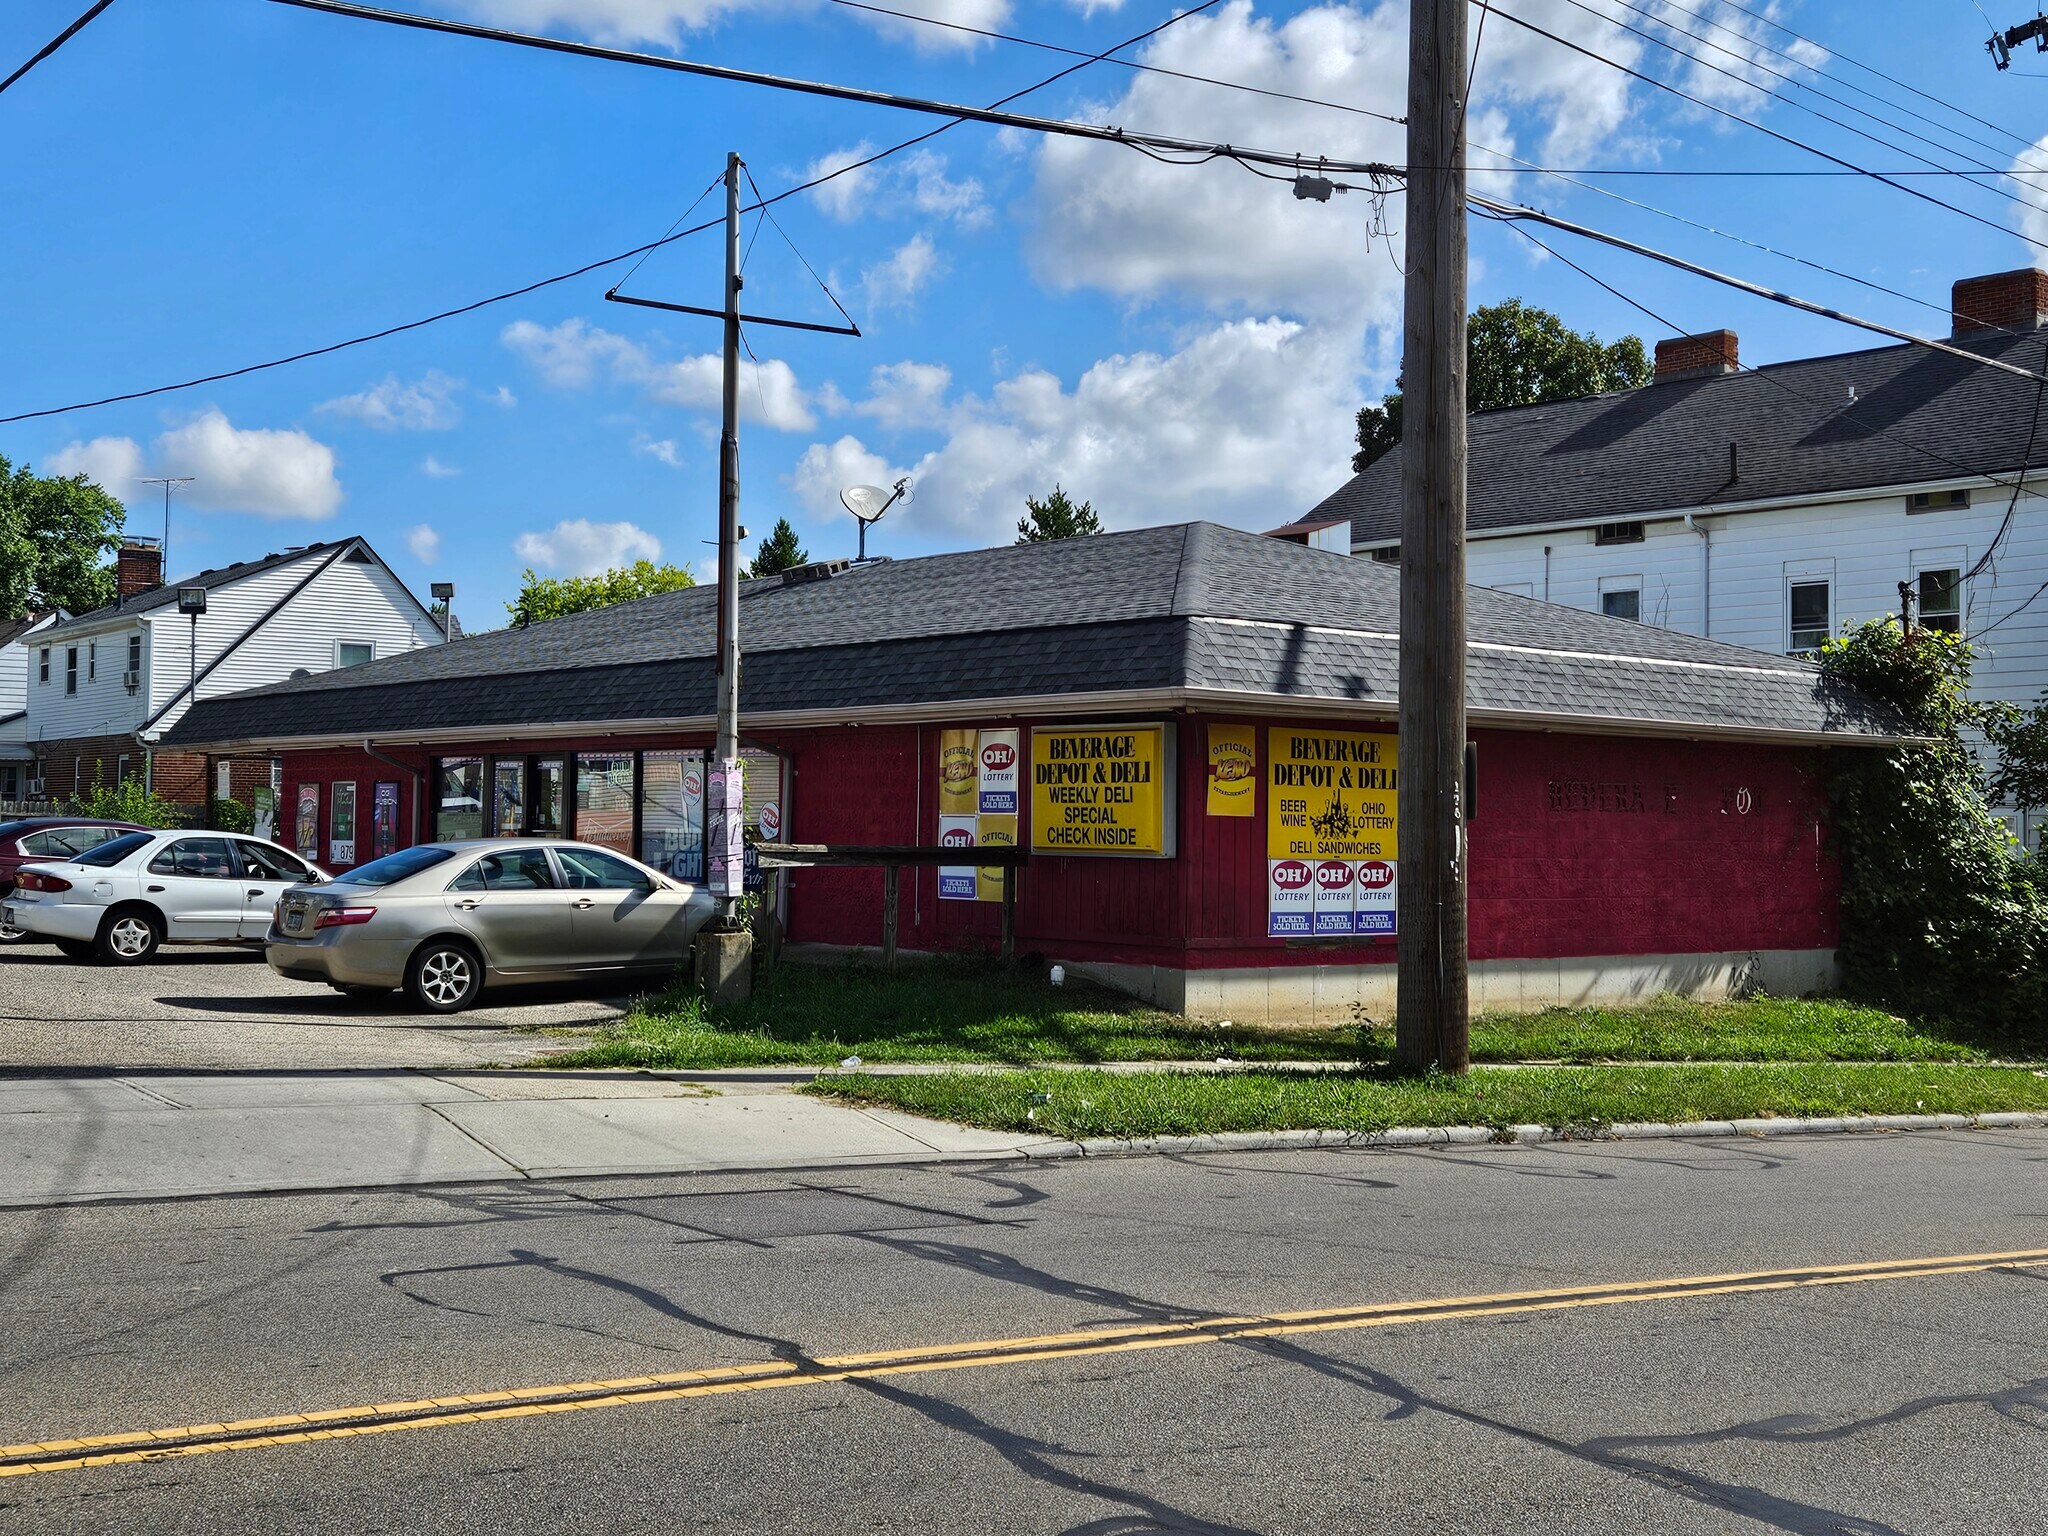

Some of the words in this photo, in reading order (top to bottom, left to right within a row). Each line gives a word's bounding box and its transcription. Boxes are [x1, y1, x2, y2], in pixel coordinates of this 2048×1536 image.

[944, 746, 975, 758] OFFICIAL
[1050, 736, 1136, 760] BEVERAGE
[1212, 743, 1252, 757] OFFICIAL
[1290, 737, 1381, 763] BEVERAGE
[983, 749, 1013, 764] OH!
[983, 773, 1014, 781] LOTTERY
[1036, 763, 1090, 784] DEPOT
[1092, 762, 1107, 784] &
[1110, 761, 1151, 783] DELI
[1274, 763, 1335, 787] DEPOT
[1338, 766, 1354, 788] &
[1358, 767, 1397, 790] DELI
[1049, 786, 1099, 804] WEEKLY
[1104, 786, 1133, 803] DELI
[983, 801, 997, 809] SOLD
[998, 801, 1014, 809] HERE
[1280, 799, 1307, 812] BEER
[1361, 802, 1386, 815] OHIO
[1064, 807, 1118, 824] SPECIAL
[1280, 814, 1307, 827] WINE
[1352, 817, 1394, 829] LOTTERY
[981, 832, 1014, 844] OFFICIAL
[1047, 827, 1091, 844] CHECK
[1094, 828, 1136, 845] INSIDE
[1290, 841, 1312, 854] DELI
[1317, 841, 1381, 855] SANDWICHES
[1274, 866, 1308, 882] OH!
[1317, 866, 1350, 882] OH!
[1359, 866, 1390, 882] OH!
[946, 879, 970, 887] TICKETS
[1274, 892, 1309, 901] LOTTERY
[1317, 892, 1351, 901] LOTTERY
[1359, 892, 1392, 900] LOTTERY
[1277, 915, 1306, 923] TICKETS
[1358, 920, 1375, 929] SOLD
[1375, 920, 1393, 929] HERE
[1362, 914, 1389, 922] TICKETS
[1273, 922, 1291, 931] SOLD
[1291, 922, 1310, 930] HERE
[1316, 921, 1333, 930] SOLD
[1333, 921, 1352, 930] HERE
